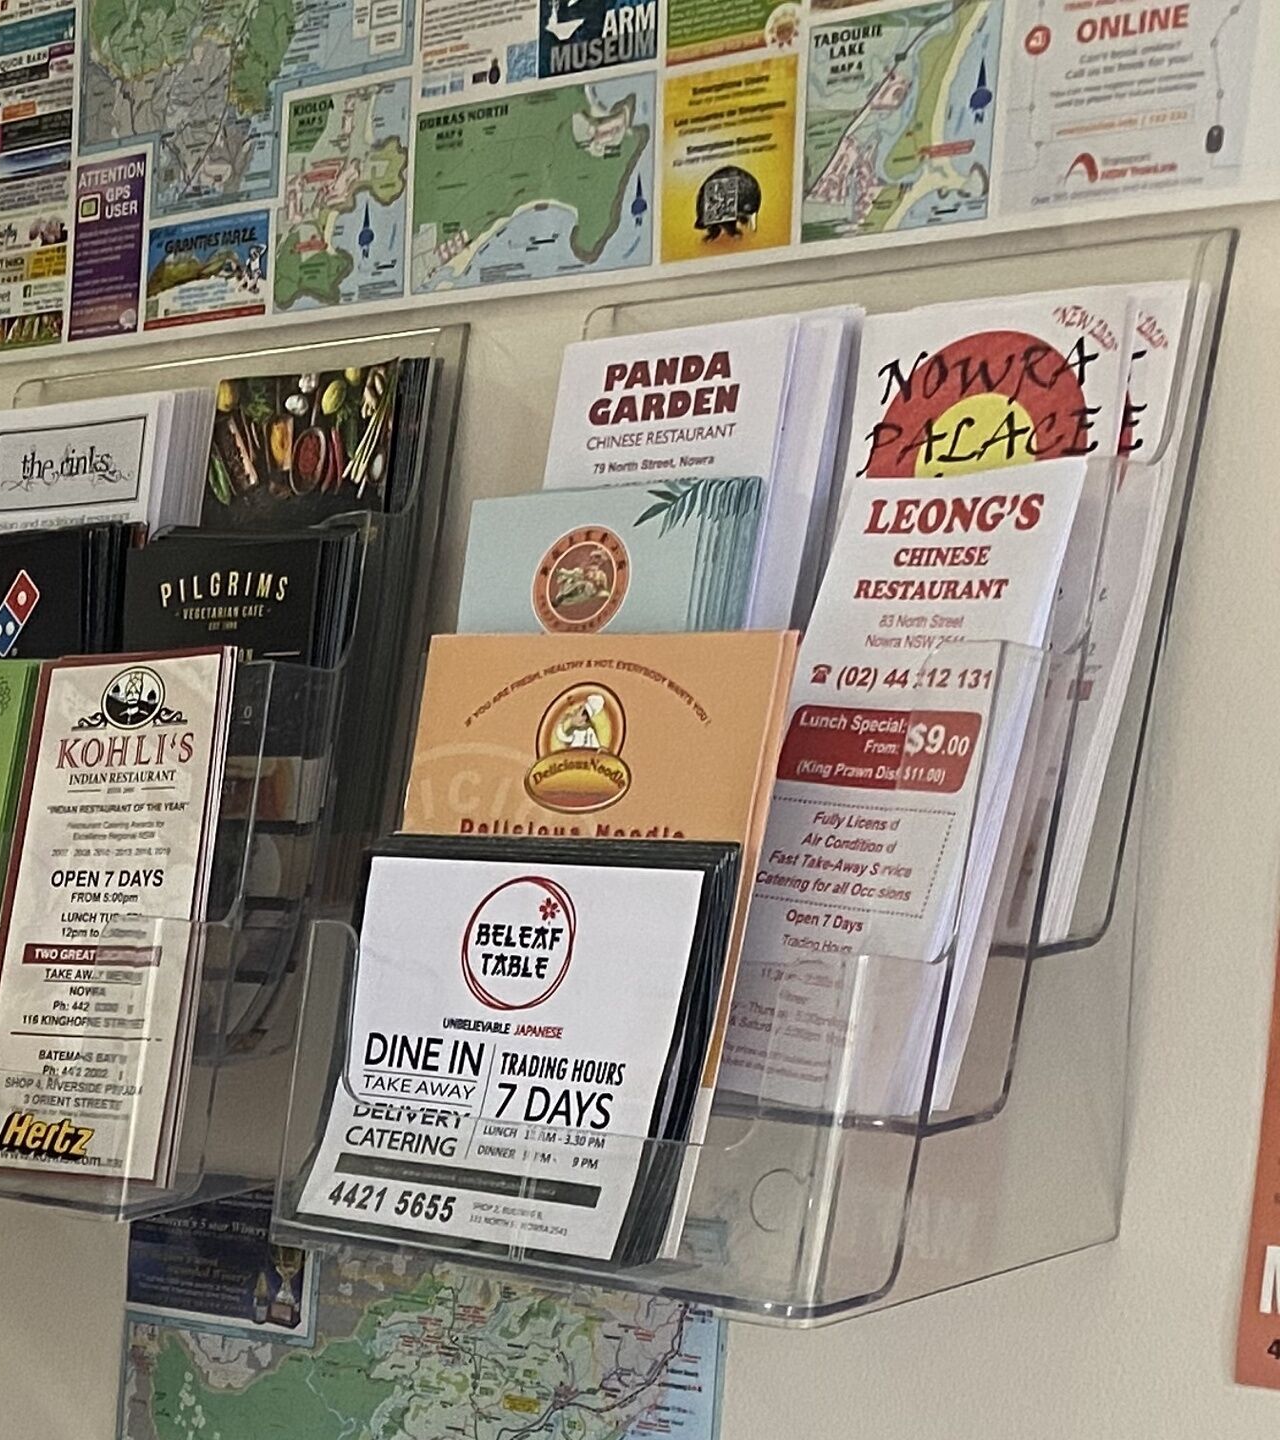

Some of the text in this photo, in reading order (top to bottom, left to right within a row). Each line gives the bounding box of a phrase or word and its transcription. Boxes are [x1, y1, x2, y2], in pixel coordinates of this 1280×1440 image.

[602, 7, 656, 38] ARM
[1077, 4, 1190, 43] ONLINE
[814, 25, 882, 48] TABOURIE
[550, 33, 656, 71] MUSEUM
[829, 42, 864, 59] LAKE
[78, 162, 145, 189] ATTENTION
[106, 185, 131, 202] GPS
[105, 200, 138, 218] USER
[603, 350, 731, 392] PANDA
[877, 337, 1099, 407] NOWRA
[588, 383, 740, 426] GARDEN
[586, 423, 737, 451] CHINESE RESTAURANT
[856, 404, 1102, 477] PALACE
[593, 454, 714, 474] 79 North Street, Nowra
[863, 493, 1045, 536] LEONG'S
[893, 546, 992, 568] CHINESE
[160, 571, 288, 608] PILGRIMS
[853, 578, 1009, 601] RESTAURANT
[836, 667, 878, 691] (02)
[883, 669, 908, 688] 44
[957, 669, 993, 691] 131
[799, 711, 906, 735] Lunch Special:
[69, 769, 176, 786] INDIAN RESTAURANT
[51, 869, 164, 887] OPEN 7 DAYS
[71, 892, 139, 905] FROM 5:00pm
[61, 913, 96, 923] LUNCH
[786, 909, 864, 933] Open 7 Days
[475, 923, 564, 951] BELEAF
[35, 949, 96, 960] TWO GREAT
[480, 953, 549, 979] TABLE
[45, 968, 73, 980] TAKE
[442, 1018, 564, 1039] UNBELIEVABLE JAPANESE
[364, 1032, 485, 1076] DINE IN
[500, 1052, 626, 1086] TRADING HOURS
[363, 1074, 475, 1100] TAKE AWAY
[353, 1102, 470, 1129] DELIVERY
[494, 1083, 614, 1130] 7 DAYS
[2, 1113, 95, 1156] Hertz
[346, 1126, 458, 1158] CATERING
[328, 1180, 388, 1212] 4421
[394, 1190, 456, 1223] 5655
